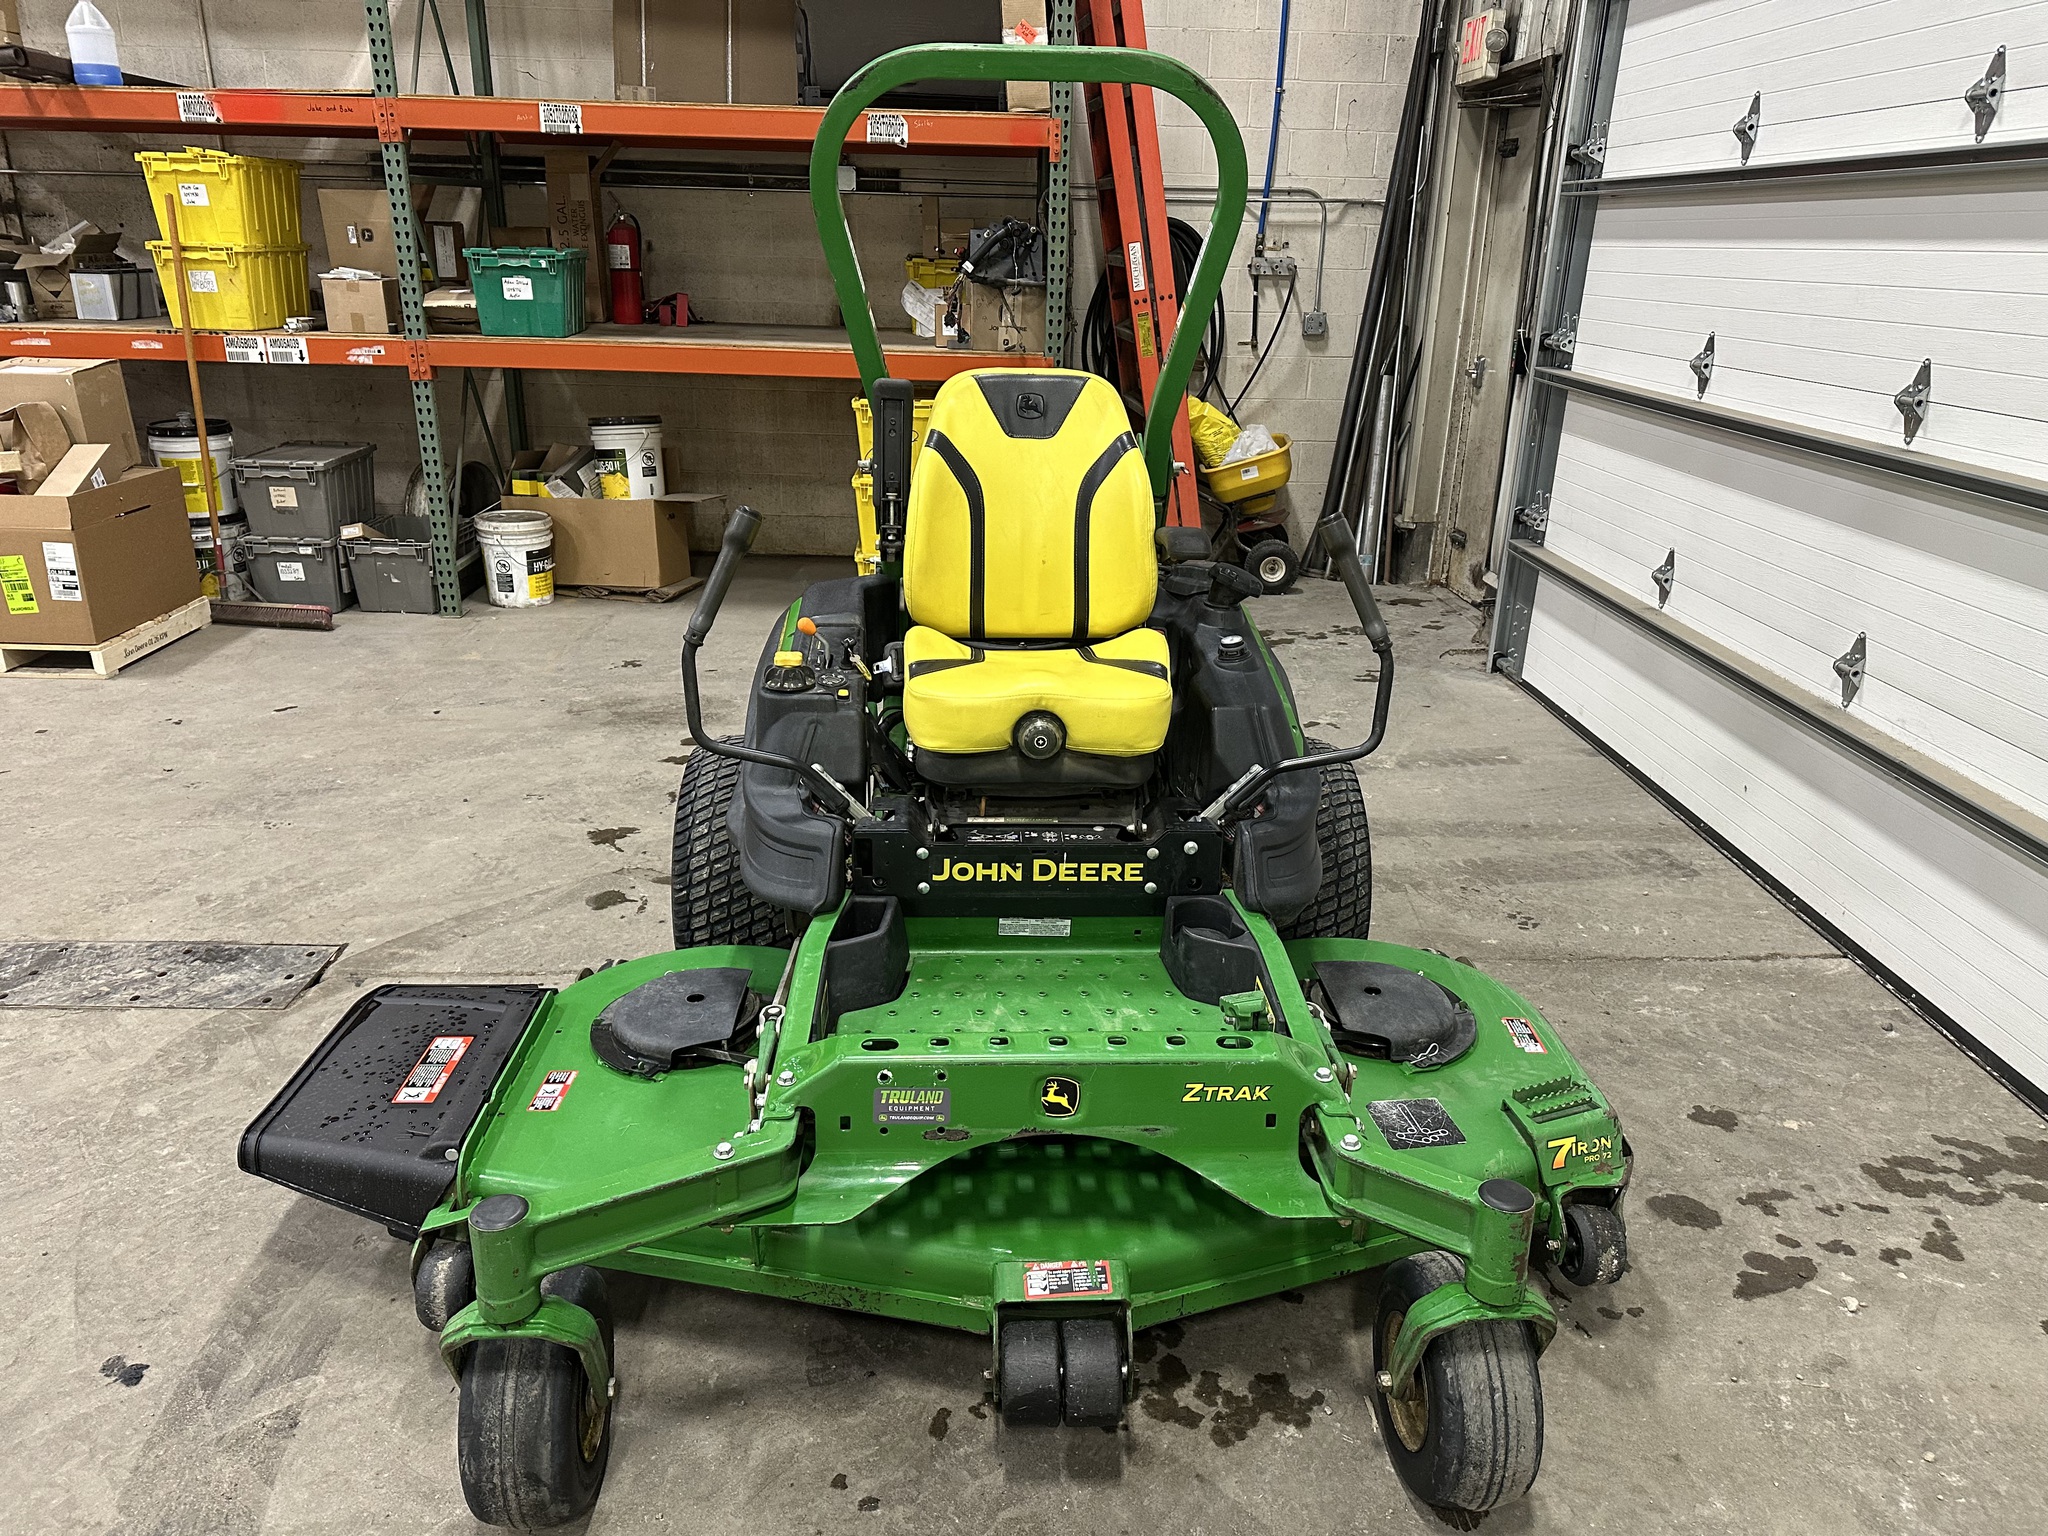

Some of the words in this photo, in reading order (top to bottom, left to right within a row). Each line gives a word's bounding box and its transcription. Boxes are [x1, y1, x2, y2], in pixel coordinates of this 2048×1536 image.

[1462, 16, 1487, 64] EXIT
[326, 104, 337, 112] and
[555, 195, 568, 225] GAL.
[570, 208, 579, 237] WATER
[559, 230, 571, 249] 2.5
[1131, 245, 1140, 289] MICHIGAN
[932, 858, 1023, 882] JOHN
[1032, 858, 1144, 882] DEERE
[880, 1090, 944, 1104] TRULAND
[1181, 1083, 1272, 1102] ZTRAK
[1584, 1154, 1600, 1163] PRO
[1602, 1151, 1612, 1160] 72
